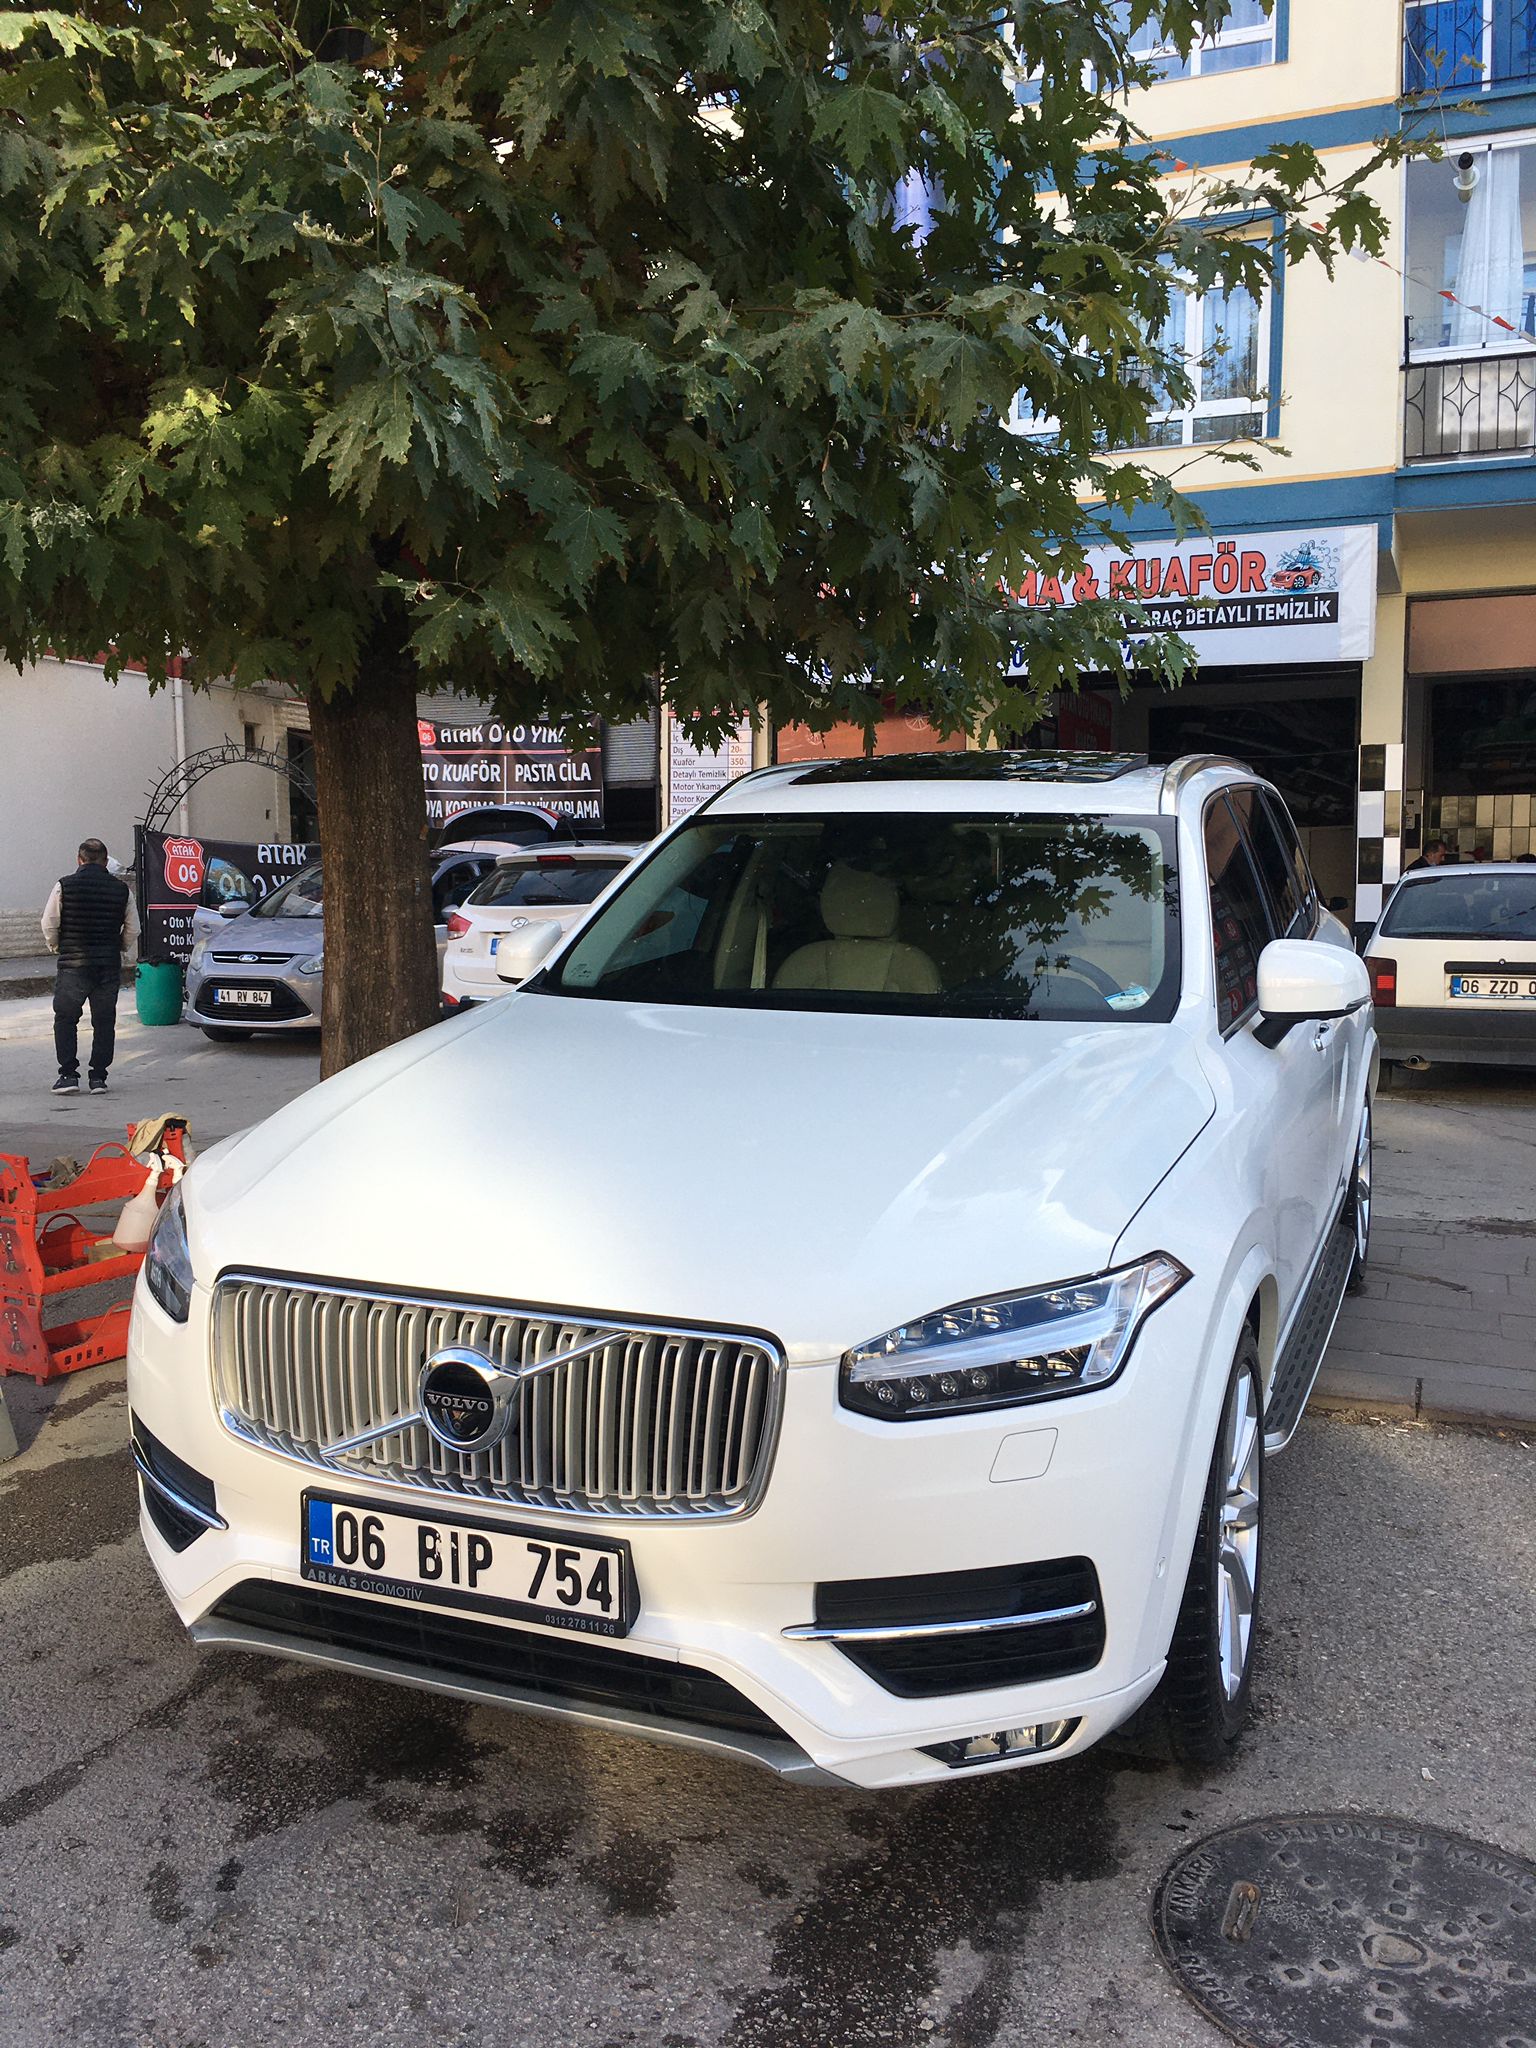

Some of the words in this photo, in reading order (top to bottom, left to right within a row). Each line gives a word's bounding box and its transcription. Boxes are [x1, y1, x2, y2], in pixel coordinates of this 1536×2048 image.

[1072, 563, 1098, 604] &
[1109, 541, 1267, 601] KUAFÖR
[1186, 603, 1251, 626] DETAYLI
[1255, 595, 1331, 622] TEMİZLİK
[440, 725, 483, 743] ATAK
[514, 762, 557, 782] PASTA
[558, 758, 592, 782] CİLA
[672, 757, 695, 766] Kuaför
[422, 763, 438, 781] TO
[442, 760, 501, 782] KUAFÖR
[672, 771, 698, 779] Detaylı
[698, 770, 726, 778] Temizlik
[695, 782, 721, 790] Yıkama
[672, 795, 694, 803] Motor
[171, 844, 195, 856] ATAK
[257, 843, 307, 865] ATAK
[178, 864, 198, 882] 06
[169, 916, 184, 928] Oto
[169, 933, 184, 945] Oto
[1461, 979, 1479, 993] 06
[1489, 980, 1519, 994] ZZD
[220, 990, 230, 1002] 41
[237, 991, 247, 1002] RV
[252, 991, 268, 1003] 847
[427, 1393, 489, 1412] VOLVO
[311, 1537, 330, 1555] TR
[335, 1510, 385, 1570] 06
[526, 1542, 616, 1612] 754
[307, 1568, 357, 1588] ARKAS
[360, 1578, 423, 1600] OTOMOTİV
[545, 1614, 566, 1626] 0312
[567, 1616, 586, 1630] 278
[602, 1622, 614, 1634] 26
